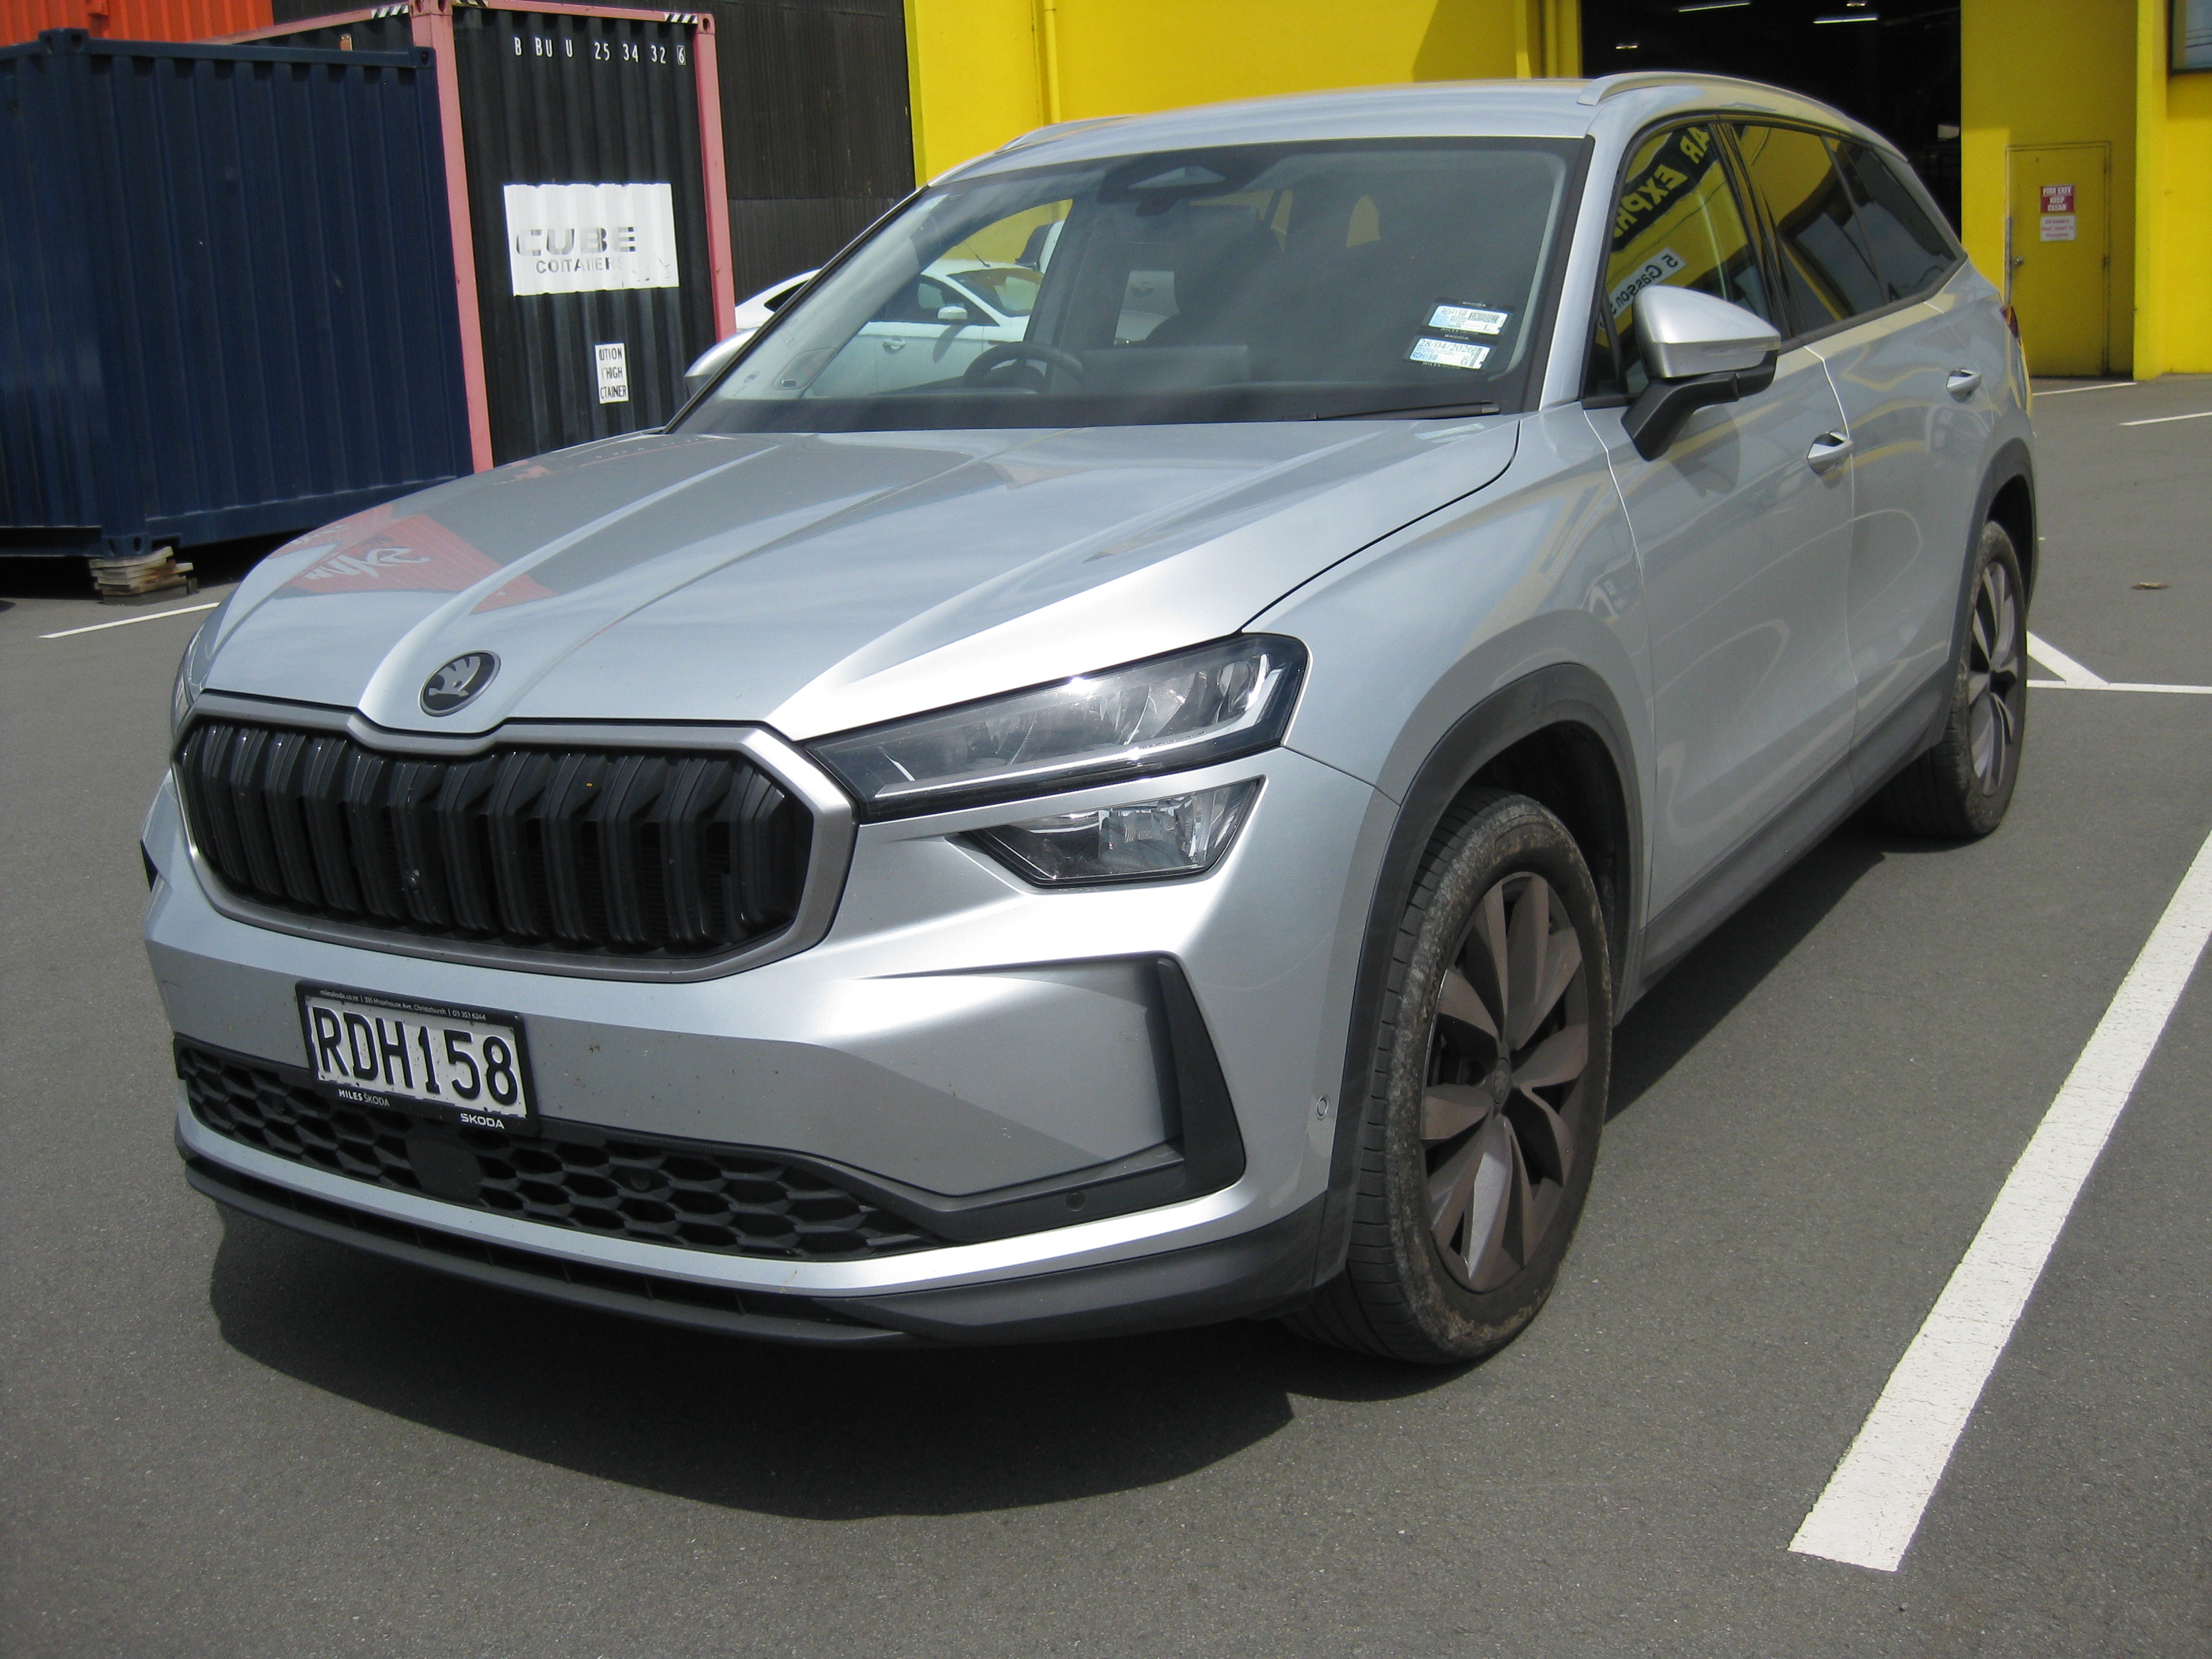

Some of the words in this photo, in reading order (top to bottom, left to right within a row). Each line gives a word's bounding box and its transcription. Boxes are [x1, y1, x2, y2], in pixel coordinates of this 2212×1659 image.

[678, 47, 685, 64] 6
[2057, 186, 2072, 194] EXIT
[2047, 203, 2067, 211] CLEAR
[2049, 196, 2065, 204] KEEP
[516, 226, 636, 257] CUBE
[1418, 339, 1475, 354] 28/04/2026
[414, 1004, 447, 1015] Christchurch
[312, 1006, 518, 1106] RDH158
[338, 1088, 363, 1101] MILES
[363, 1092, 390, 1107] ŠKODA
